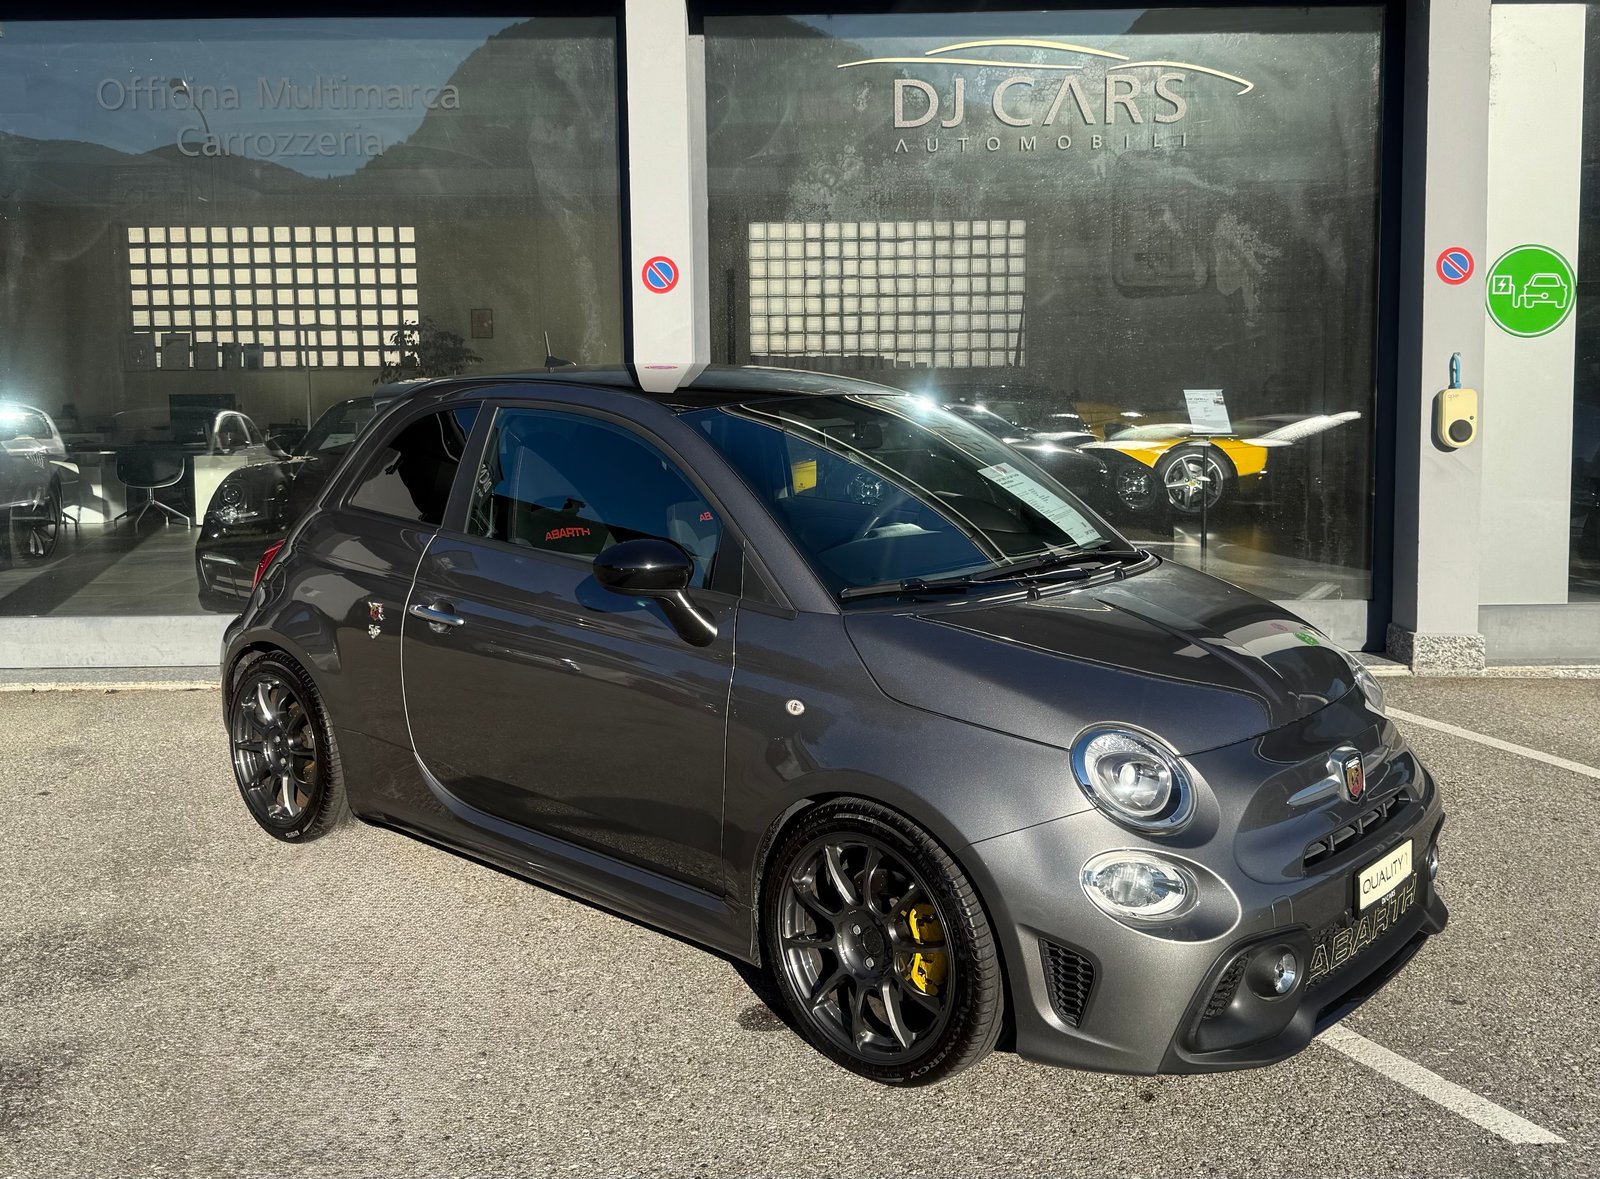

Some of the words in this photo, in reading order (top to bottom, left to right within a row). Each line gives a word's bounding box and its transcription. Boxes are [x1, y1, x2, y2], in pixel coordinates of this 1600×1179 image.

[96, 76, 241, 111] Officina
[257, 76, 460, 111] Multimarca
[893, 77, 965, 129] DJ
[991, 73, 1187, 128] CARS
[175, 126, 384, 158] Carrozzeria
[894, 132, 1187, 154] AUTOMOBILI
[545, 527, 591, 541] ABARTH
[1363, 854, 1404, 894] QUALITY
[1306, 874, 1417, 984] ABARTH
